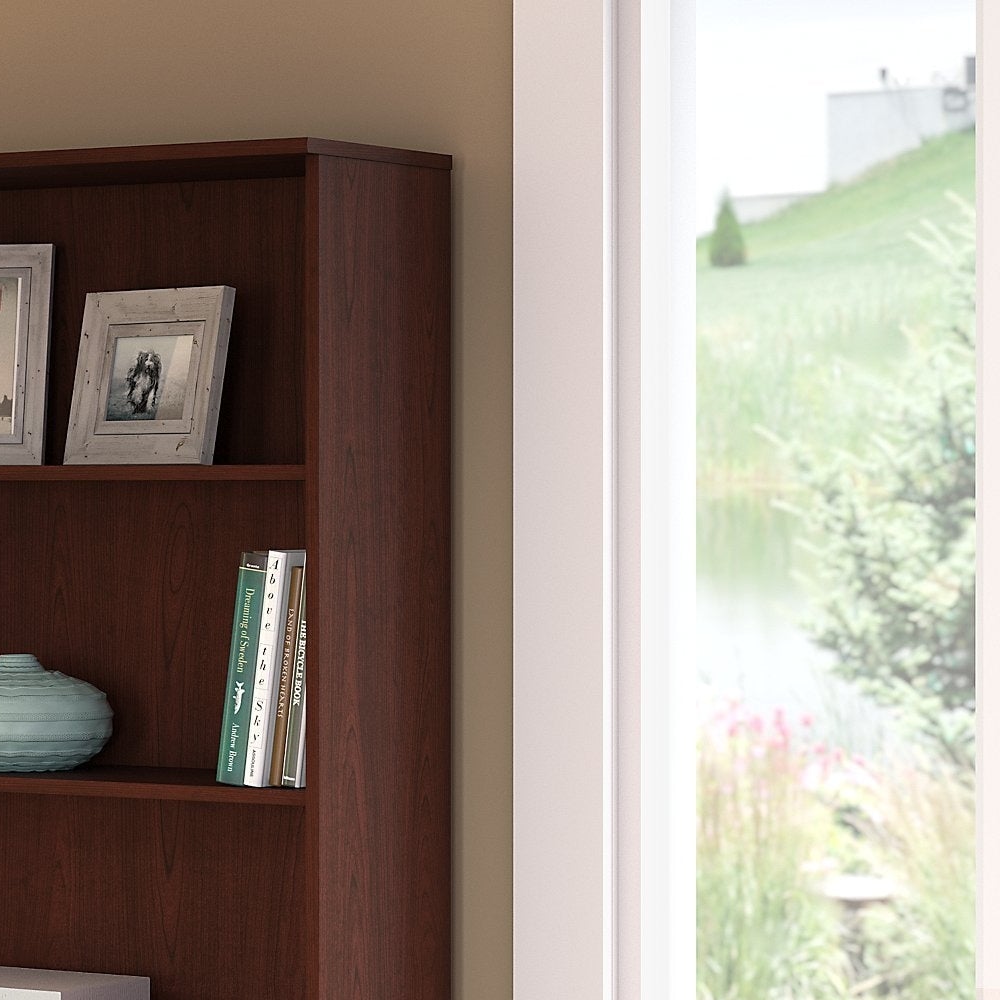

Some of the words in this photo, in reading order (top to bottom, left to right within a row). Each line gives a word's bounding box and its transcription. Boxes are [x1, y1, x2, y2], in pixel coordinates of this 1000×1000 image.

[239, 588, 256, 629] Dreaming
[264, 560, 280, 630] Above
[240, 630, 250, 640] of
[285, 634, 291, 646] OF
[237, 640, 249, 673] Sweden
[258, 647, 266, 686] the
[282, 648, 290, 682] BROKEN
[296, 640, 306, 678] BICYCLE
[277, 685, 286, 719] HEARTS
[293, 680, 302, 706] BOOK
[230, 722, 240, 749] Andrew
[250, 700, 264, 746] Sky
[227, 750, 237, 772] Brown
